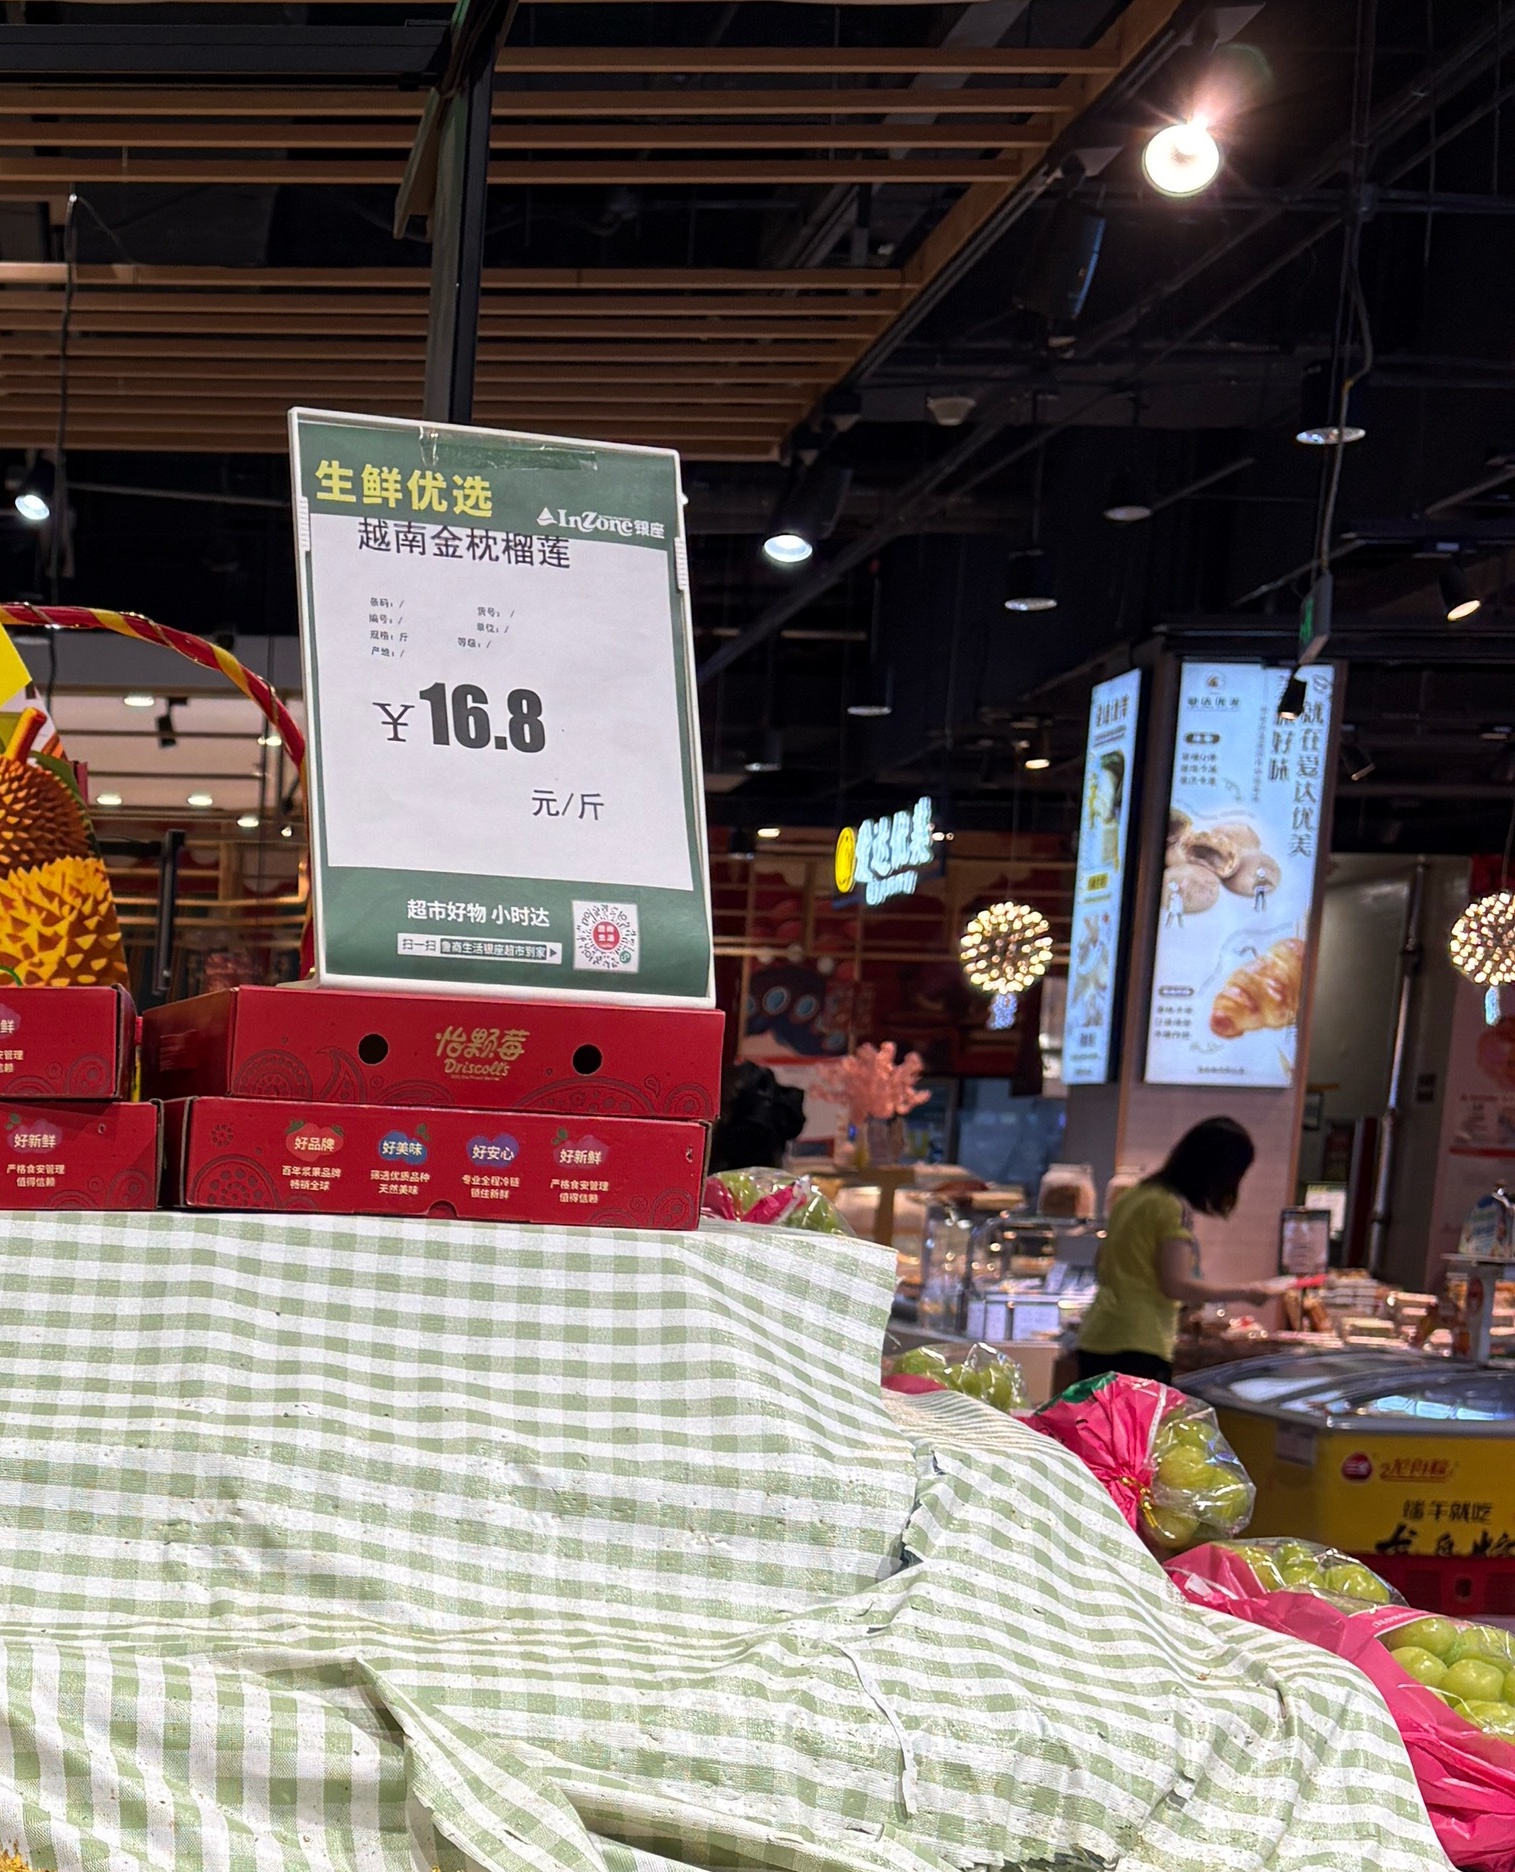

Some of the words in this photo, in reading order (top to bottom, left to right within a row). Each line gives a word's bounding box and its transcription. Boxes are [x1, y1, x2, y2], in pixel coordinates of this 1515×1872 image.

[315, 460, 493, 518] 生鲜优选
[557, 509, 633, 536] InZone
[634, 520, 665, 540] 银座
[358, 517, 571, 569] 越南金枕榴莲
[532, 789, 604, 820] 元/斤
[407, 899, 486, 923] 超市好物
[491, 904, 550, 927] 小时达
[402, 938, 436, 952] 扫一扫
[435, 1025, 530, 1061] 怡颗莓
[444, 1058, 510, 1077] Driscoll's
[15, 1134, 56, 1148] 好新鲜
[295, 1136, 334, 1152] 好品牌
[382, 1141, 422, 1156] 好美味
[472, 1144, 514, 1161] 好安心
[560, 1149, 601, 1165] 好新鲜
[379, 1182, 421, 1195] 天然美味
